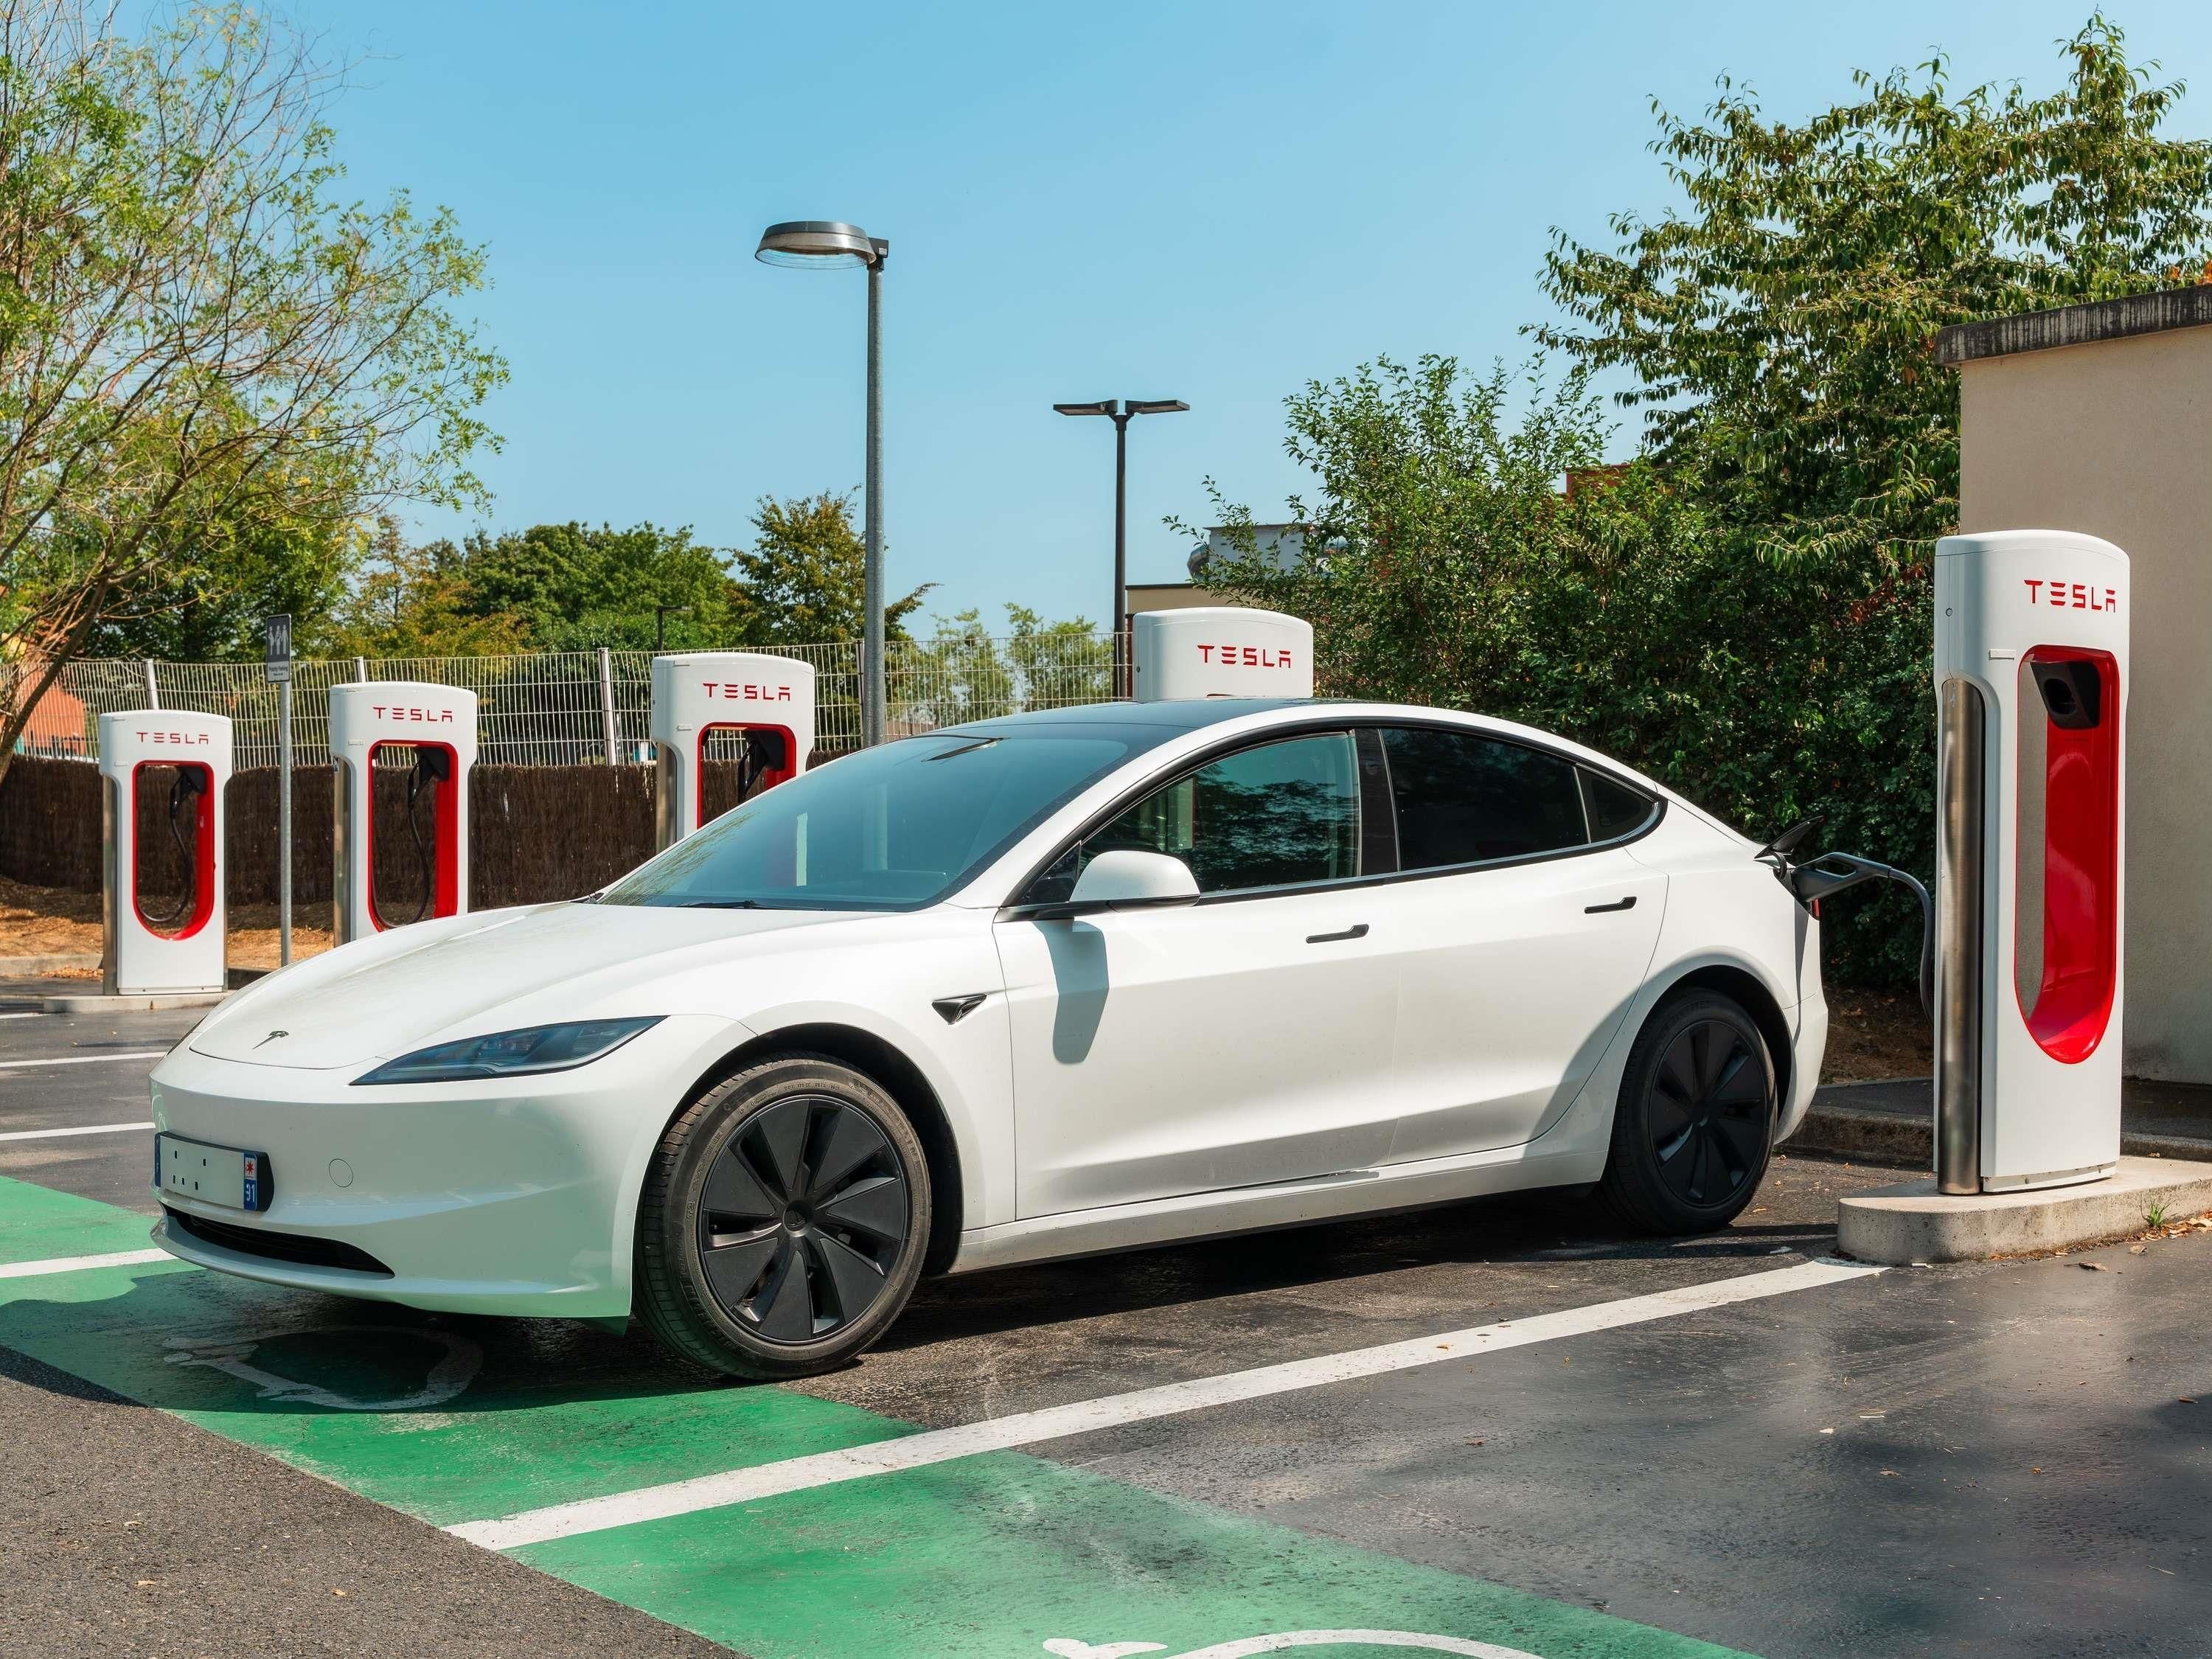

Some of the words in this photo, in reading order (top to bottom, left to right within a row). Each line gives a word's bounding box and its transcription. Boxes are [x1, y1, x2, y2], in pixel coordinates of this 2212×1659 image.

[2023, 579, 2117, 613] TESLA
[1197, 644, 1292, 668] TESLA
[703, 683, 791, 701] TESLA
[372, 706, 453, 723] TESLA
[136, 731, 209, 745] TESLA
